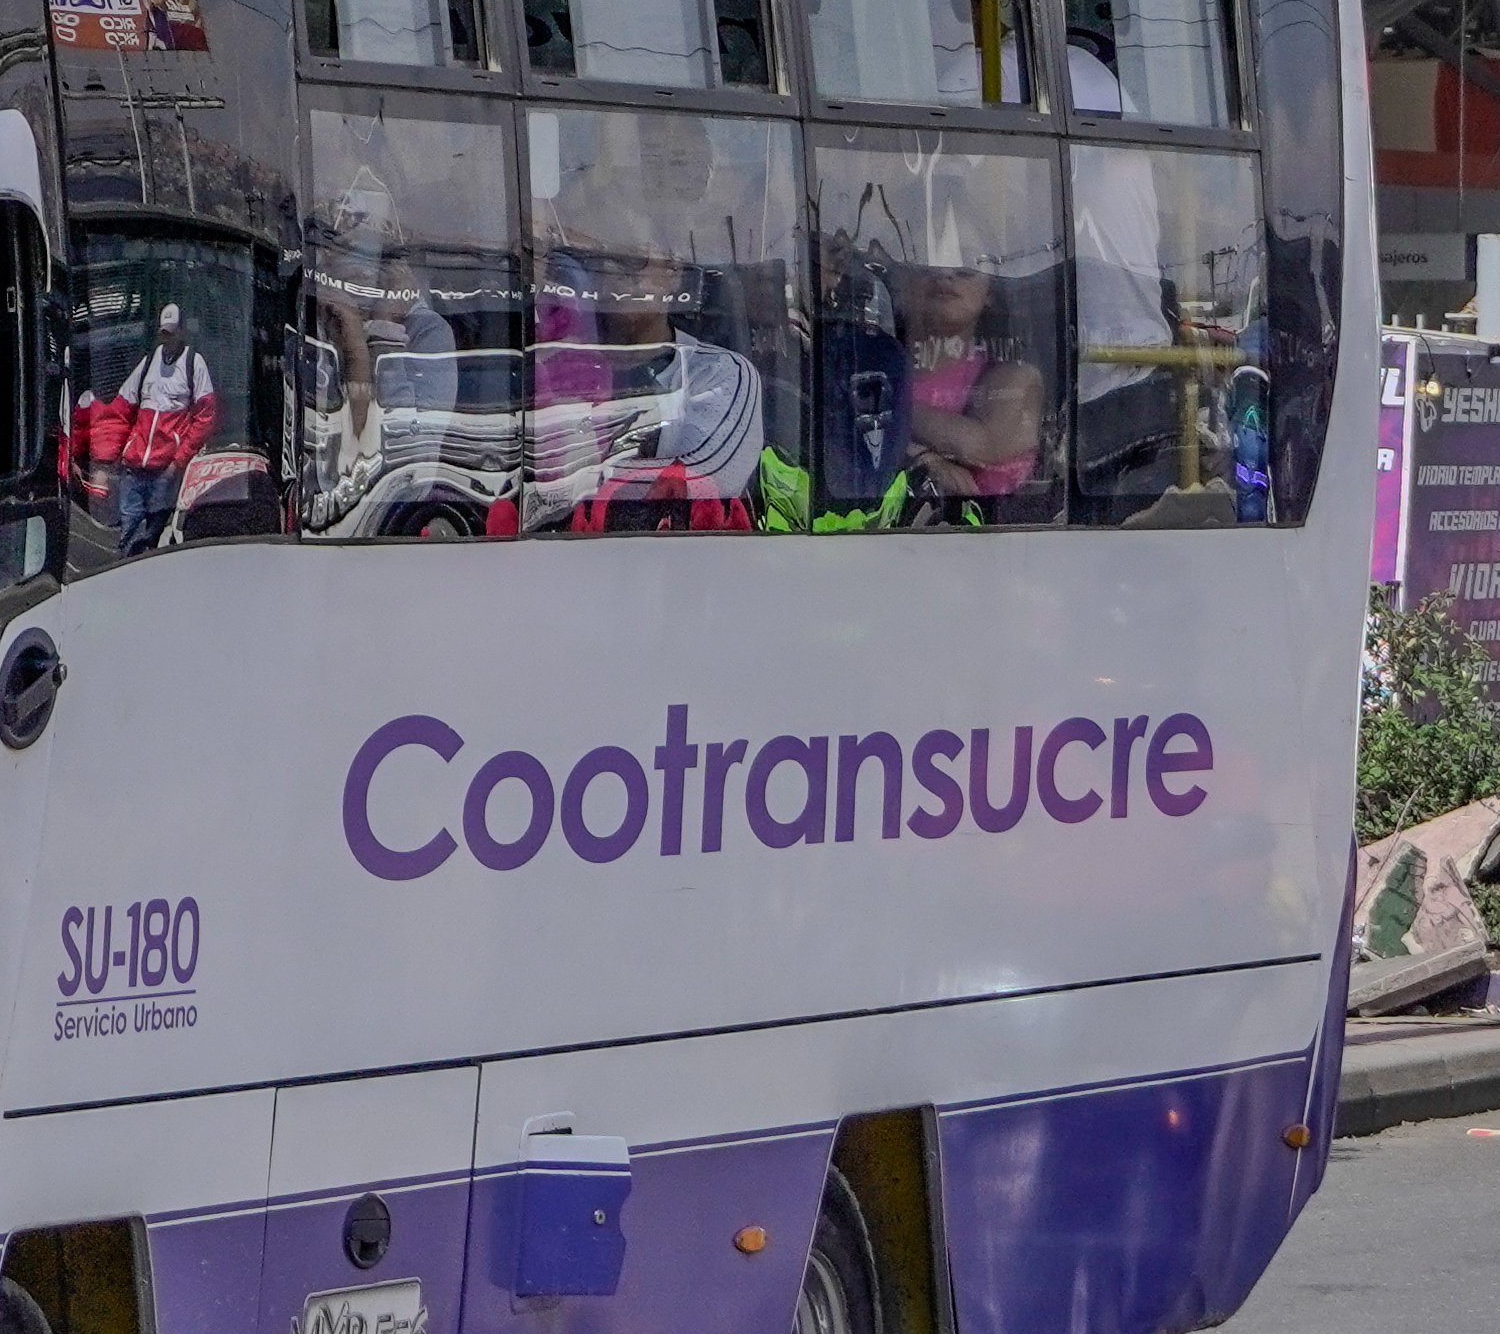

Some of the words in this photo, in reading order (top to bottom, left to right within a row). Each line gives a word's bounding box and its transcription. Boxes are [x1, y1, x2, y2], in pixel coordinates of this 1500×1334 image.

[1417, 465, 1459, 486] VIDRIO
[342, 702, 1214, 881] Cootransucre
[57, 896, 200, 997] SU-180
[54, 1004, 127, 1042] Servicio
[133, 1001, 198, 1033] Urbano
